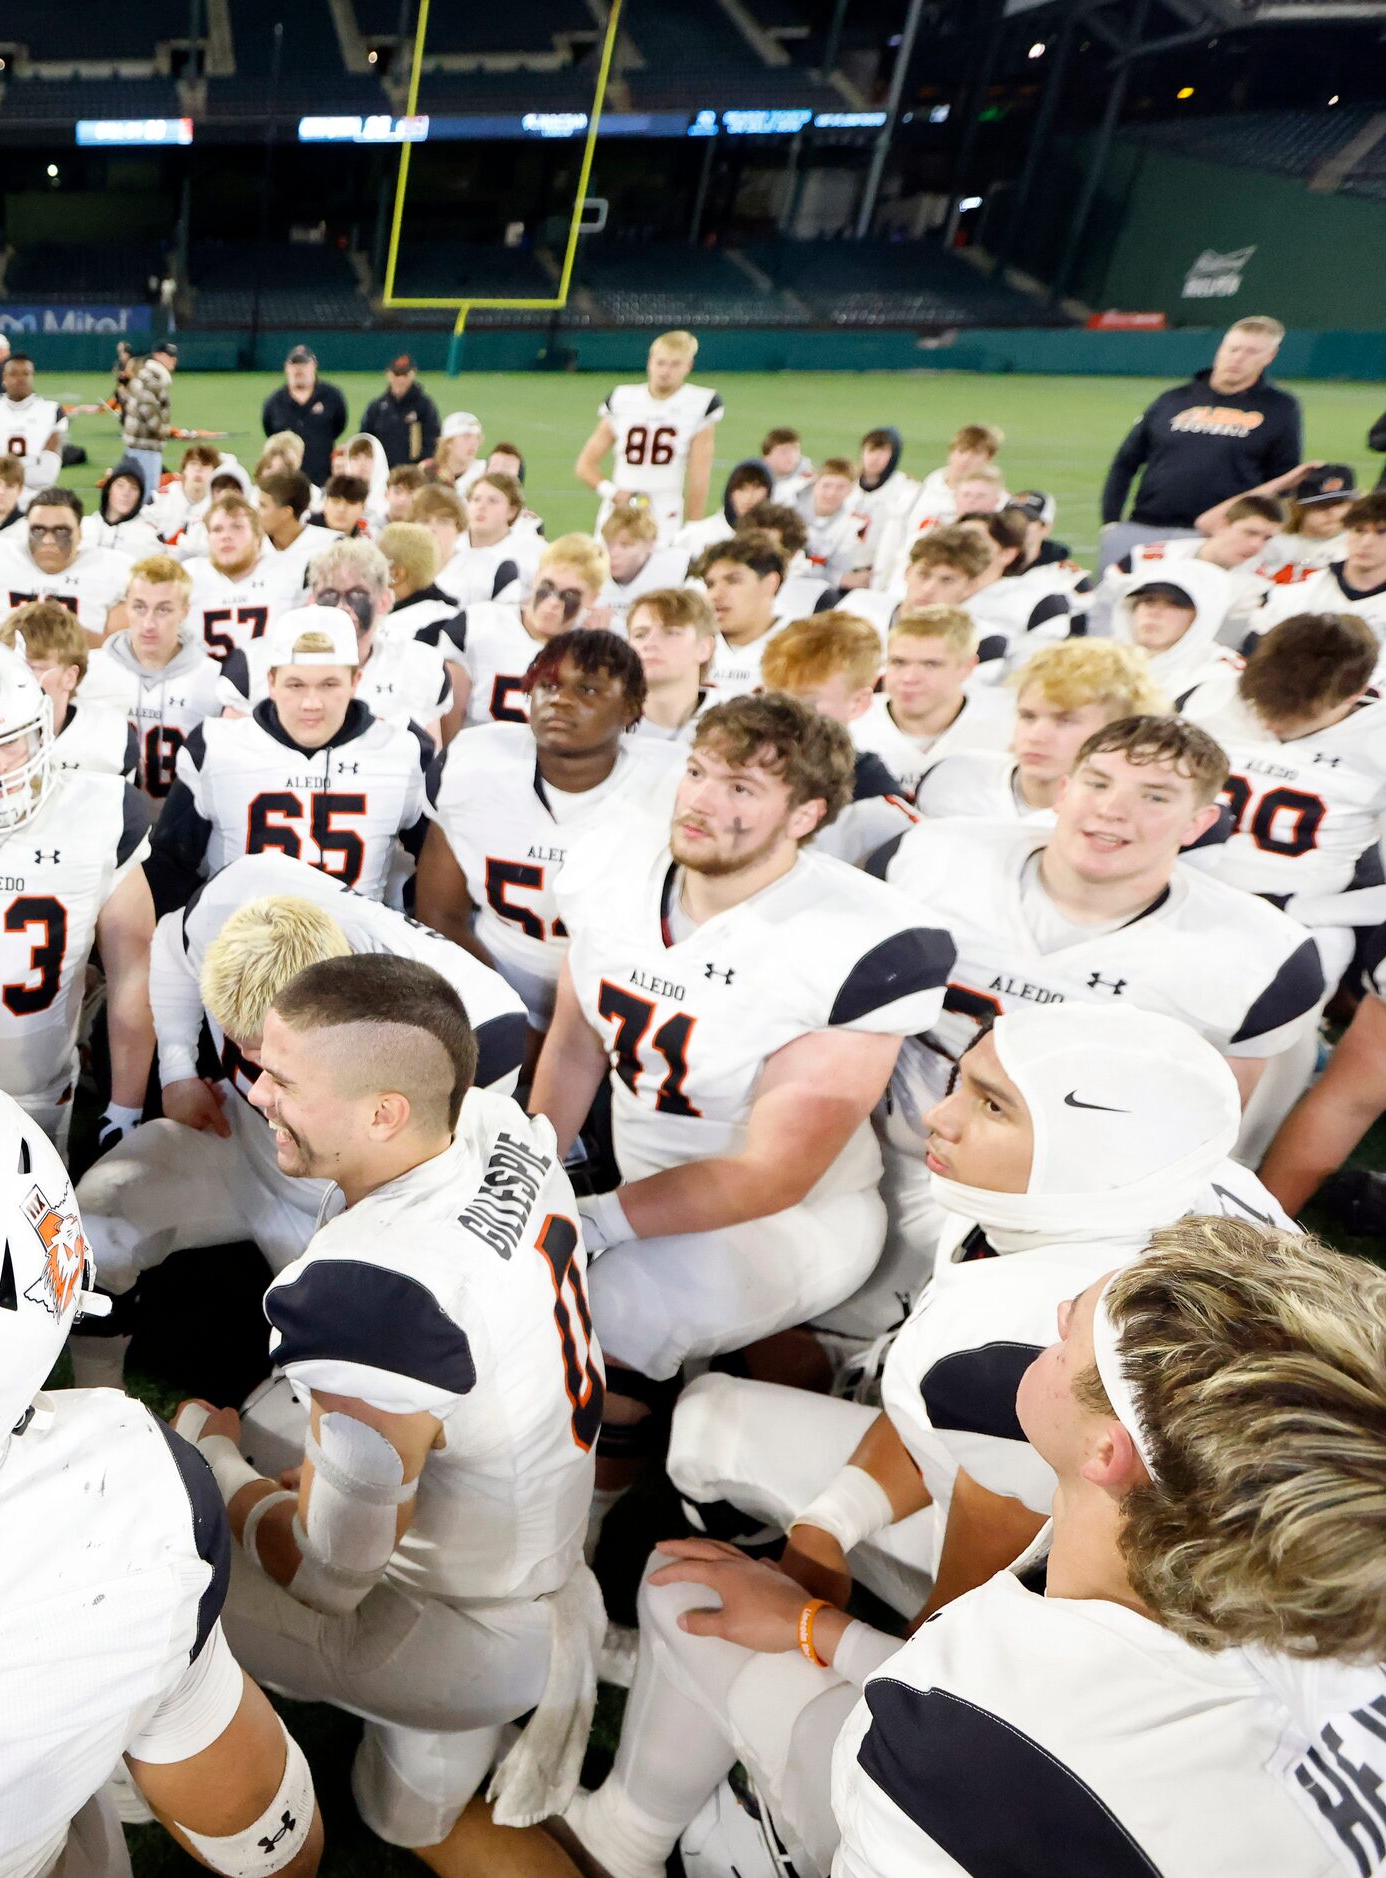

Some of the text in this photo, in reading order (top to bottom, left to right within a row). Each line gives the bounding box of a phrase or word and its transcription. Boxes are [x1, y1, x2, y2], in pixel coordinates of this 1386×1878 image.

[625, 426, 677, 465] 86
[203, 606, 268, 660] 57
[246, 791, 367, 889] 65
[630, 967, 686, 1002] ALEDO
[597, 979, 703, 1118] 71
[456, 1132, 552, 1262] GILLESPIE
[1295, 1694, 1386, 1878] HE
